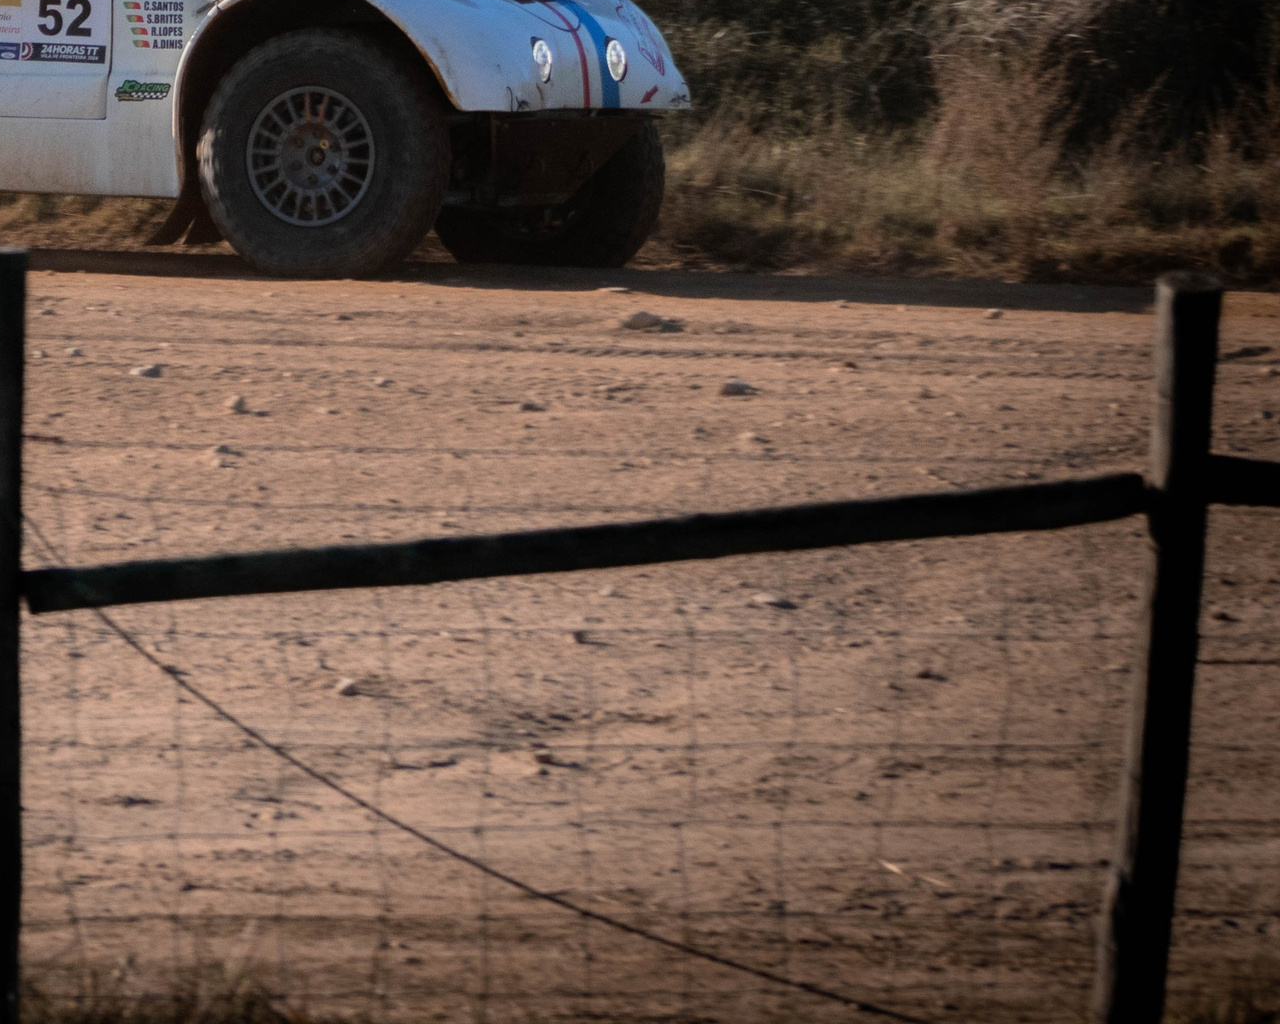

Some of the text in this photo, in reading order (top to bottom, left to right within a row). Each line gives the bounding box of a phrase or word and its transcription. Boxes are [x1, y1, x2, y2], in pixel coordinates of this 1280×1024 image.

[144, 1, 184, 11] C.SANTOS
[147, 14, 183, 24] S.BRITES
[151, 26, 183, 36] R.LOPES
[152, 39, 183, 49] A.DINIS
[86, 46, 99, 56] TT
